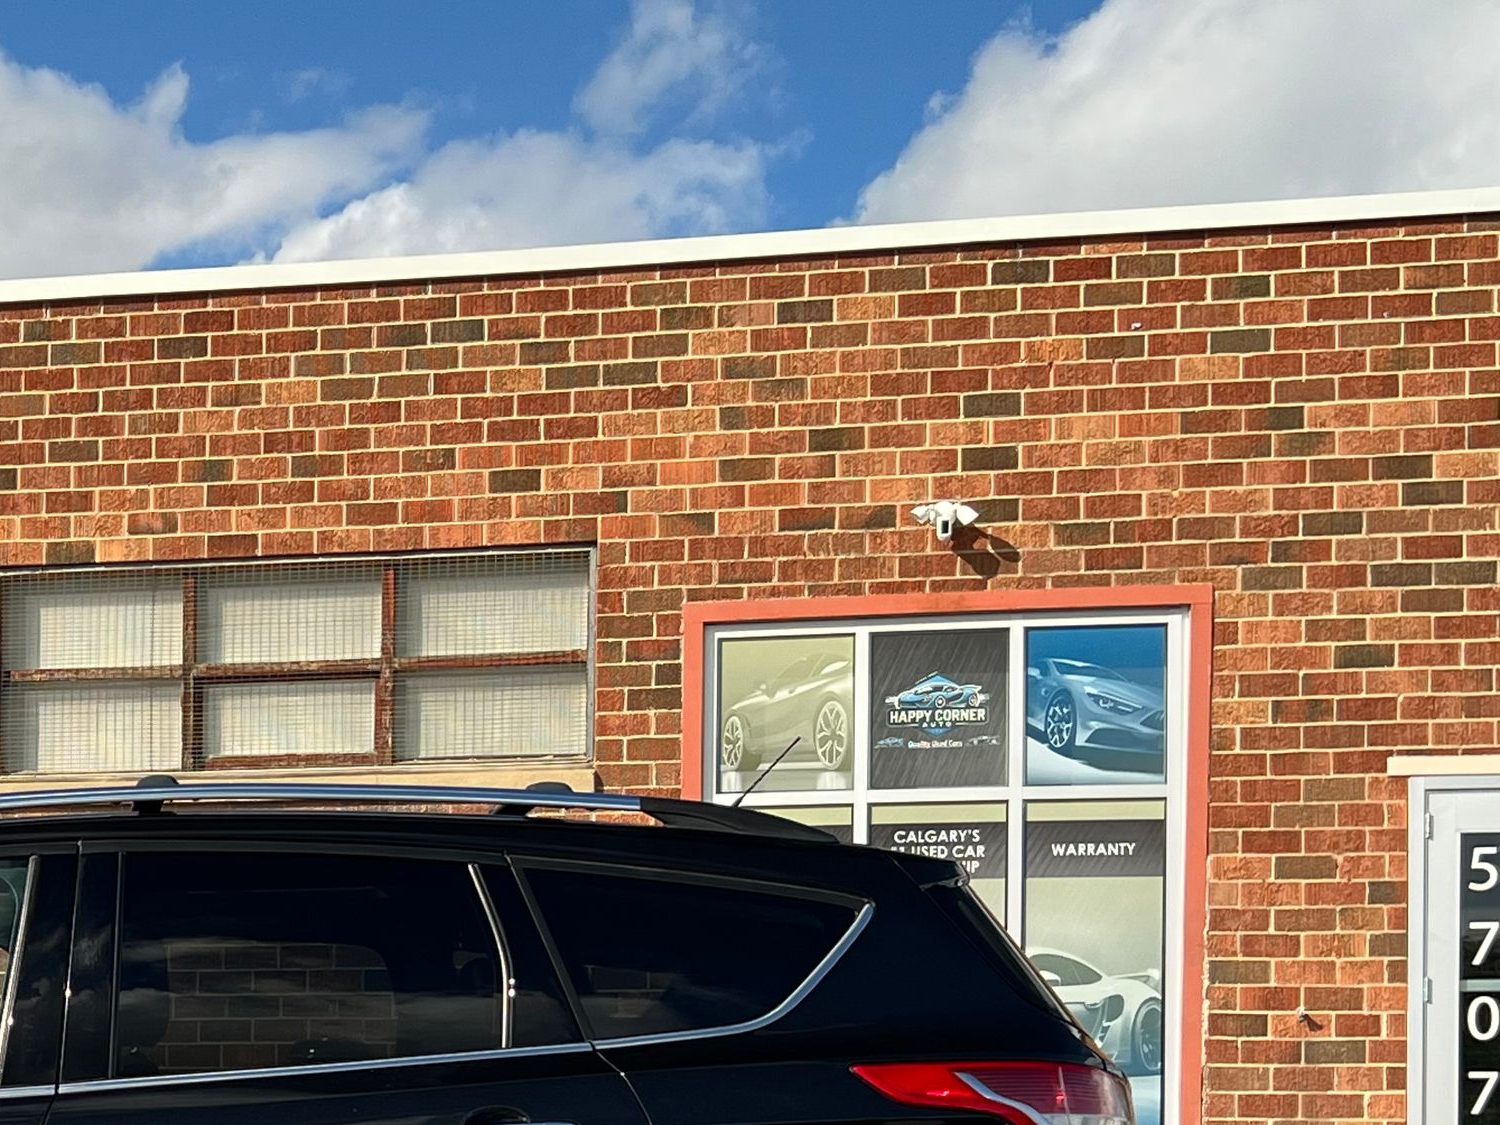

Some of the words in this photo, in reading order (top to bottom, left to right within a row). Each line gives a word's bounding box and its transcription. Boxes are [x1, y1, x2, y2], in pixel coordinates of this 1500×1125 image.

[890, 709, 932, 723] HAPPY
[934, 708, 986, 721] CORNER
[893, 829, 981, 843] CALGARY'S
[911, 845, 948, 858] USED
[952, 845, 986, 858] CAR
[1051, 842, 1136, 857] WARRANTY
